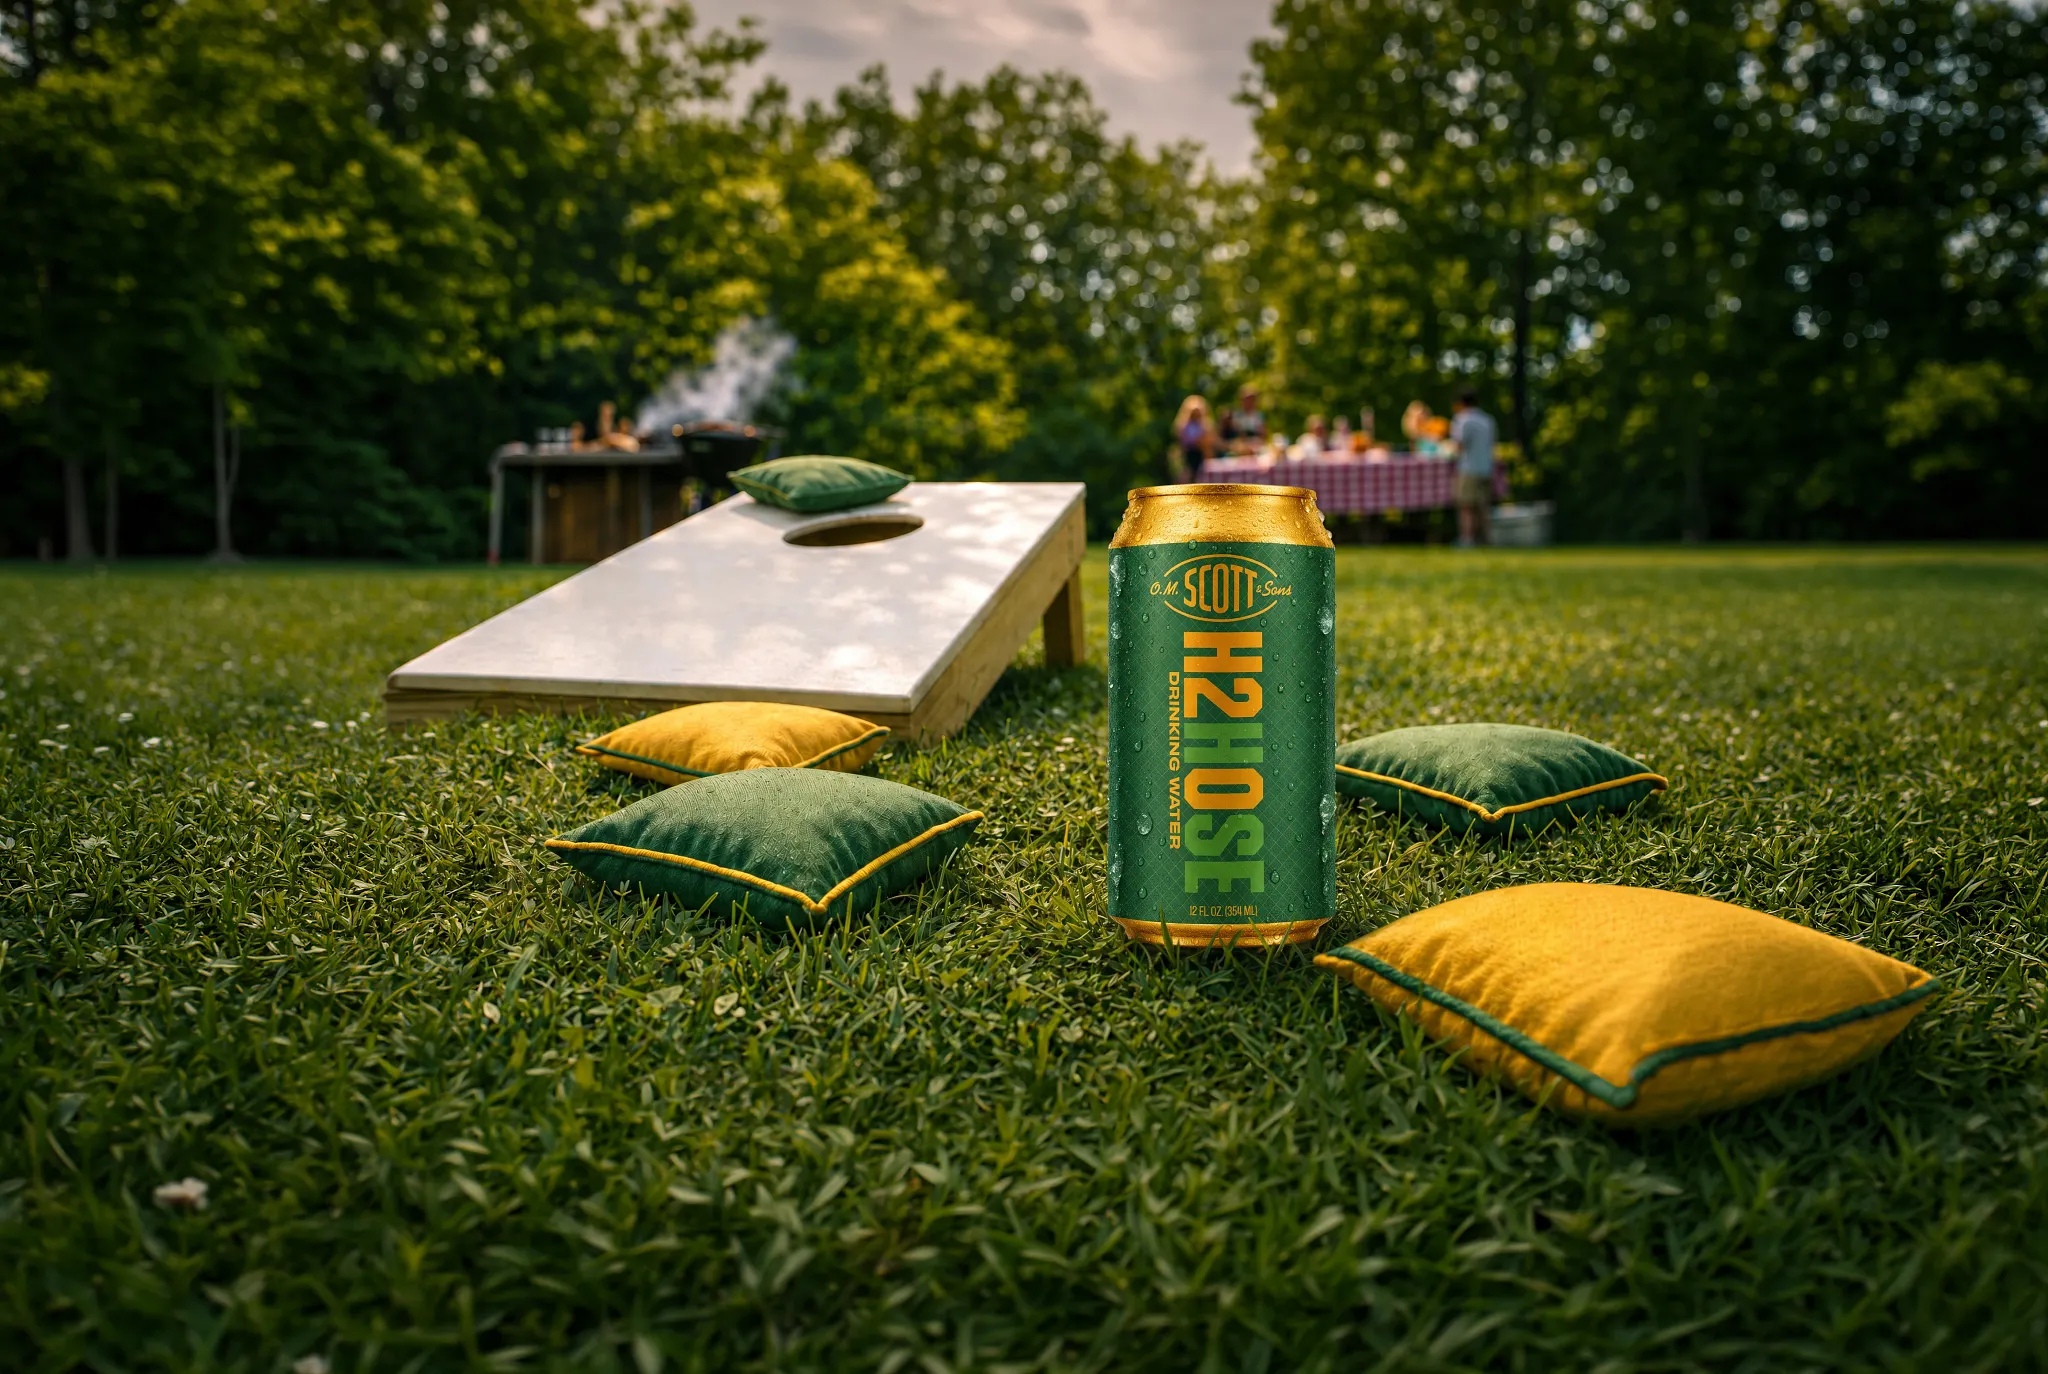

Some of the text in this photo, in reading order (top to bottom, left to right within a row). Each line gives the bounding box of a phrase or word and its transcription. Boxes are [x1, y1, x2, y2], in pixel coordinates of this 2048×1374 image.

[1149, 581, 1179, 596] O.M.
[1183, 563, 1258, 614] SCOTT
[1261, 580, 1292, 597] Sons
[1168, 671, 1181, 850] DRINKING WATER
[1183, 631, 1265, 893] H2HOSE
[1189, 905, 1258, 918] 12 FL OZ. (354 ML)
